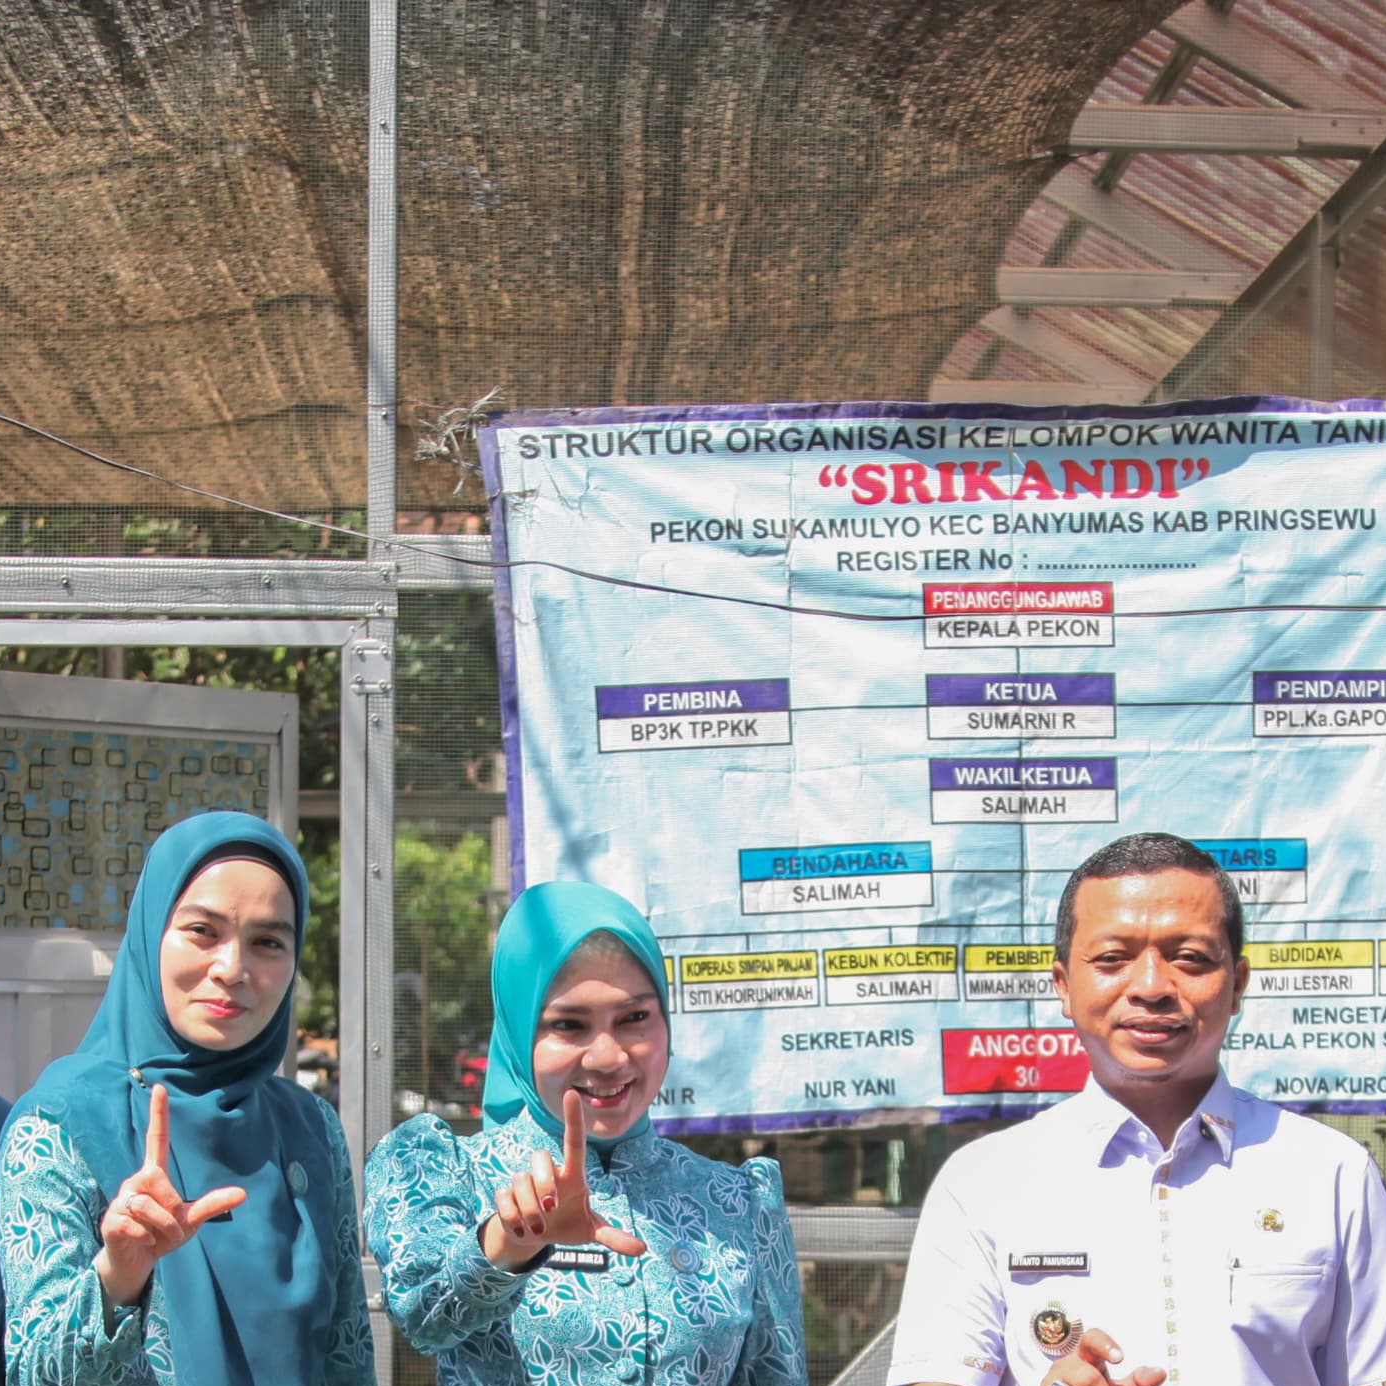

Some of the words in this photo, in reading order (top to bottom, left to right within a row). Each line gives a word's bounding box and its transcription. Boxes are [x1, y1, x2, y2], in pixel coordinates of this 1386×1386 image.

[519, 427, 714, 460] STRUKTUR
[726, 425, 948, 454] ORGANISASI
[959, 422, 1159, 450] KELOMPOK
[1171, 420, 1301, 446] WANITA
[1310, 418, 1386, 445] TANI
[650, 518, 743, 543] PEKON
[752, 516, 922, 542] SUKAMULYO
[929, 515, 984, 538] KEC
[992, 511, 1145, 536] BANYUMAS
[1153, 509, 1209, 534] KAB
[1216, 508, 1378, 533] PRINGSEWU
[836, 549, 971, 572] REGISTER
[979, 549, 1013, 571] No
[937, 619, 1022, 640] KEPALA
[1027, 618, 1101, 638] PEKON
[643, 689, 743, 712] PEMBINA
[984, 682, 1058, 702] KETUA
[630, 721, 684, 743] BP3K
[687, 718, 759, 740] TP.PKK
[966, 712, 1057, 731] SUMARNI
[1061, 712, 1077, 730] R
[981, 796, 1067, 816] SALIMAH
[772, 850, 909, 876] BENDAHARA
[792, 881, 882, 903] SALIMAH
[827, 953, 878, 971] KEBUN
[883, 950, 955, 969] KOLEKTIF
[1268, 946, 1344, 965] BUDIDAYA
[855, 978, 933, 998] SALIMAH
[968, 978, 1014, 996] MIMAH
[1260, 975, 1290, 992] WIJI
[1293, 974, 1354, 992] LESTARI
[688, 989, 712, 1007] SITI
[780, 1028, 915, 1053] SEKRETARIS
[968, 1034, 1088, 1059] ANGGOTA
[1302, 1030, 1376, 1050] PEKON
[681, 1086, 696, 1106] R
[804, 1081, 848, 1101] NUR
[850, 1079, 896, 1098] YANI
[1274, 1076, 1330, 1096] NOVA
